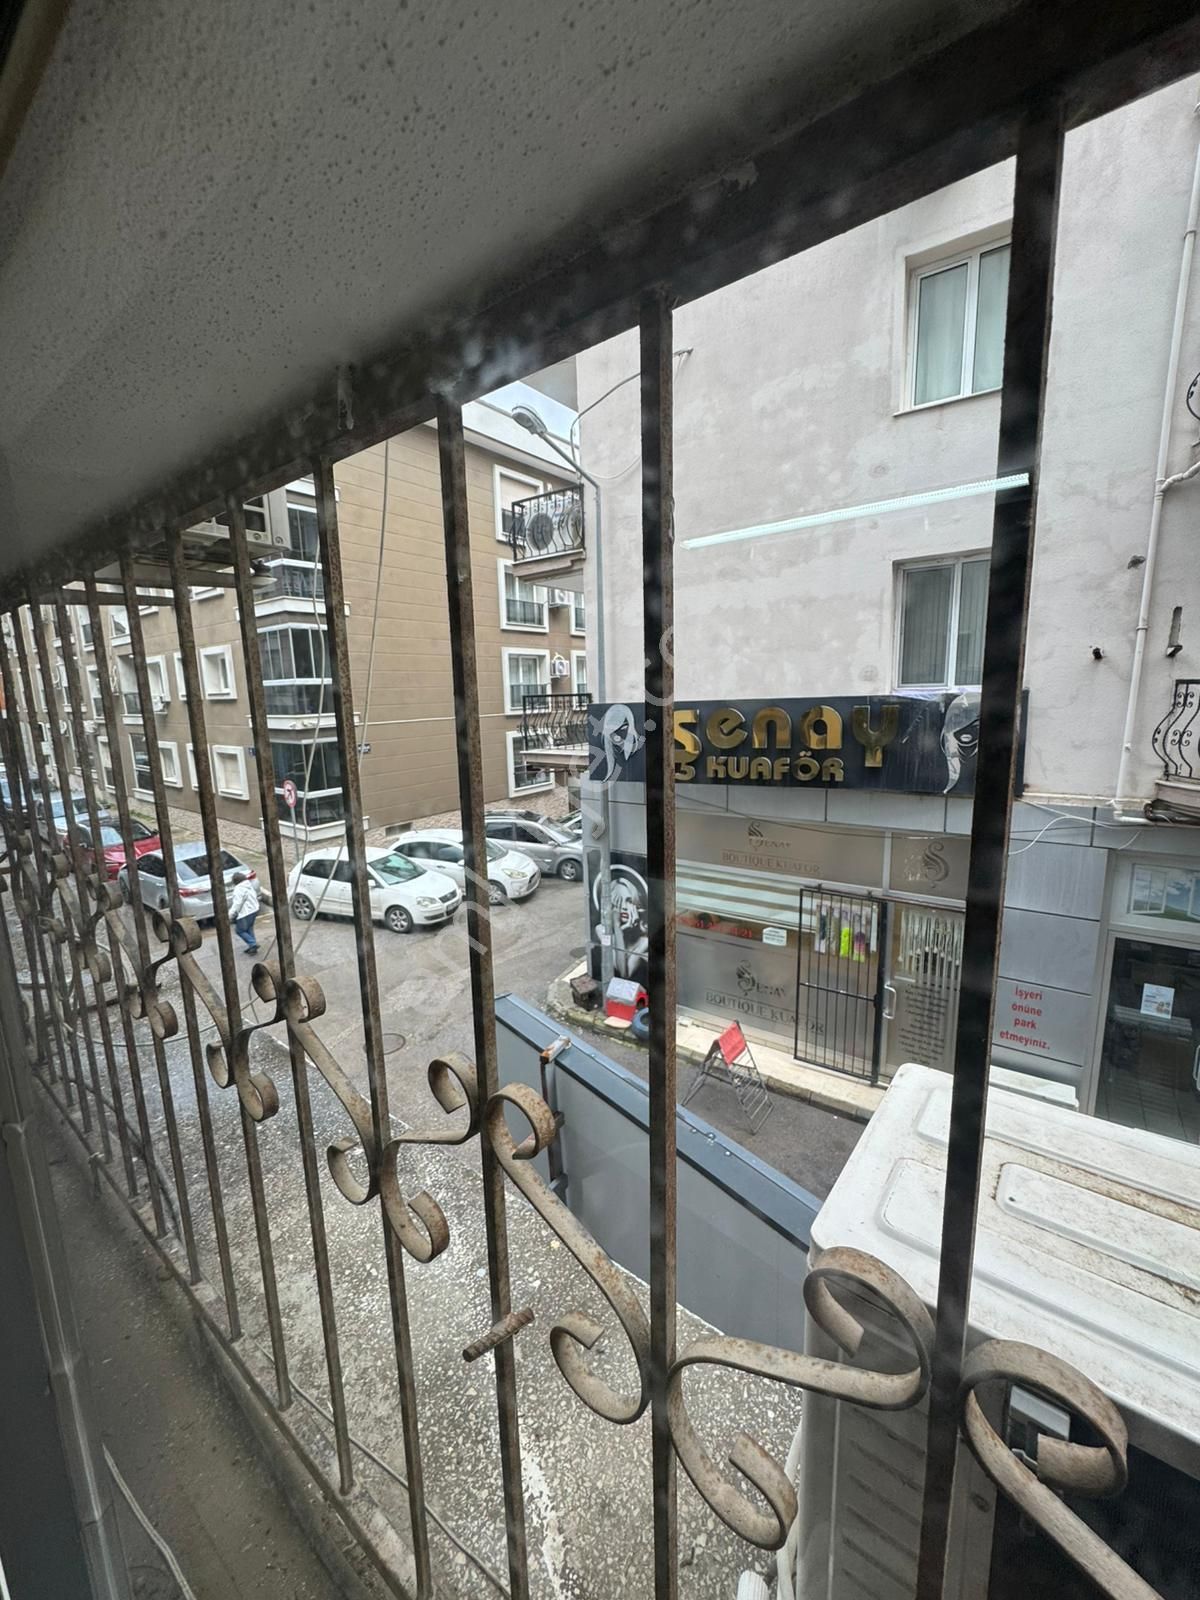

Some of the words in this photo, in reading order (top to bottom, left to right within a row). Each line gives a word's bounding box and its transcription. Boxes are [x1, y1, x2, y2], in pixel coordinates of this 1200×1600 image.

[706, 750, 844, 782] KUAFÖR
[705, 991, 767, 1018] BOUTIQUE
[1013, 1017, 1037, 1030] park
[999, 1029, 1051, 1050] etmeyiniz.
